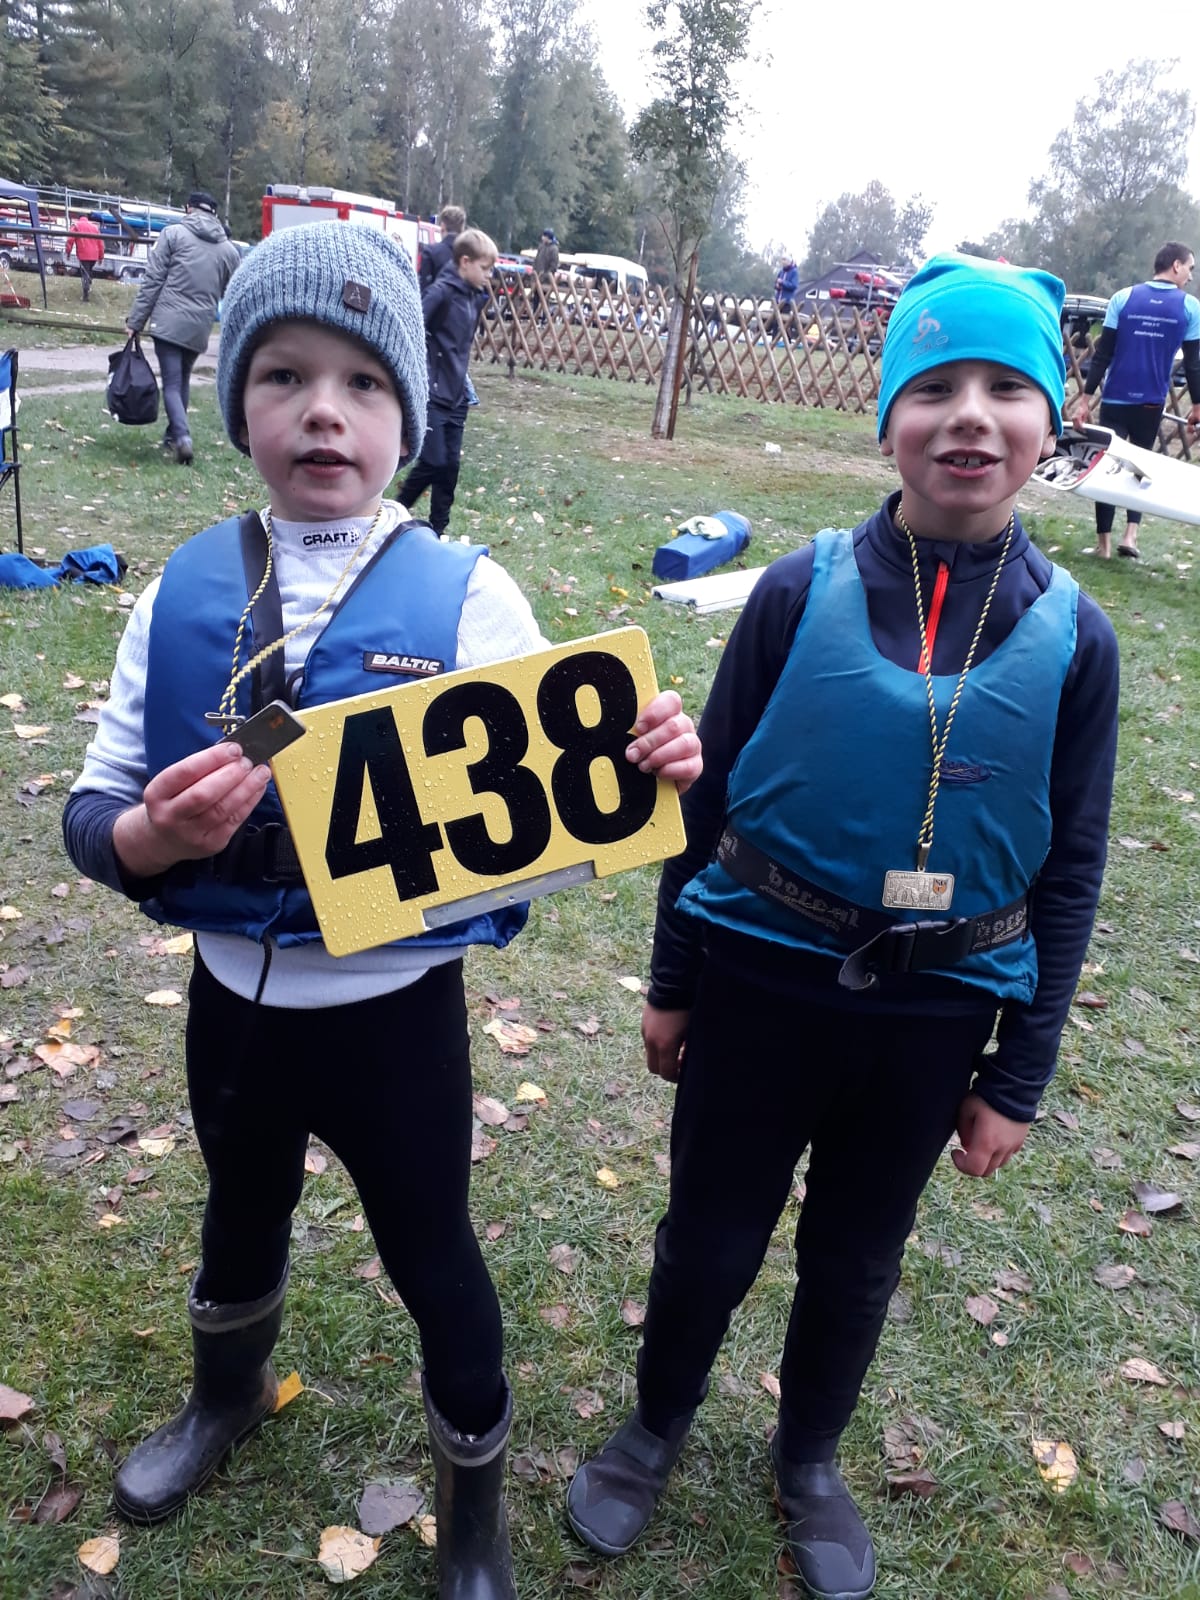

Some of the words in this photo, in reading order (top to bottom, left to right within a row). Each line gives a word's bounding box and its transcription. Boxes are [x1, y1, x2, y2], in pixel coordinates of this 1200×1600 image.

[303, 532, 348, 546] CRAFT
[371, 654, 440, 672] BALTIC
[325, 651, 657, 902] 438
